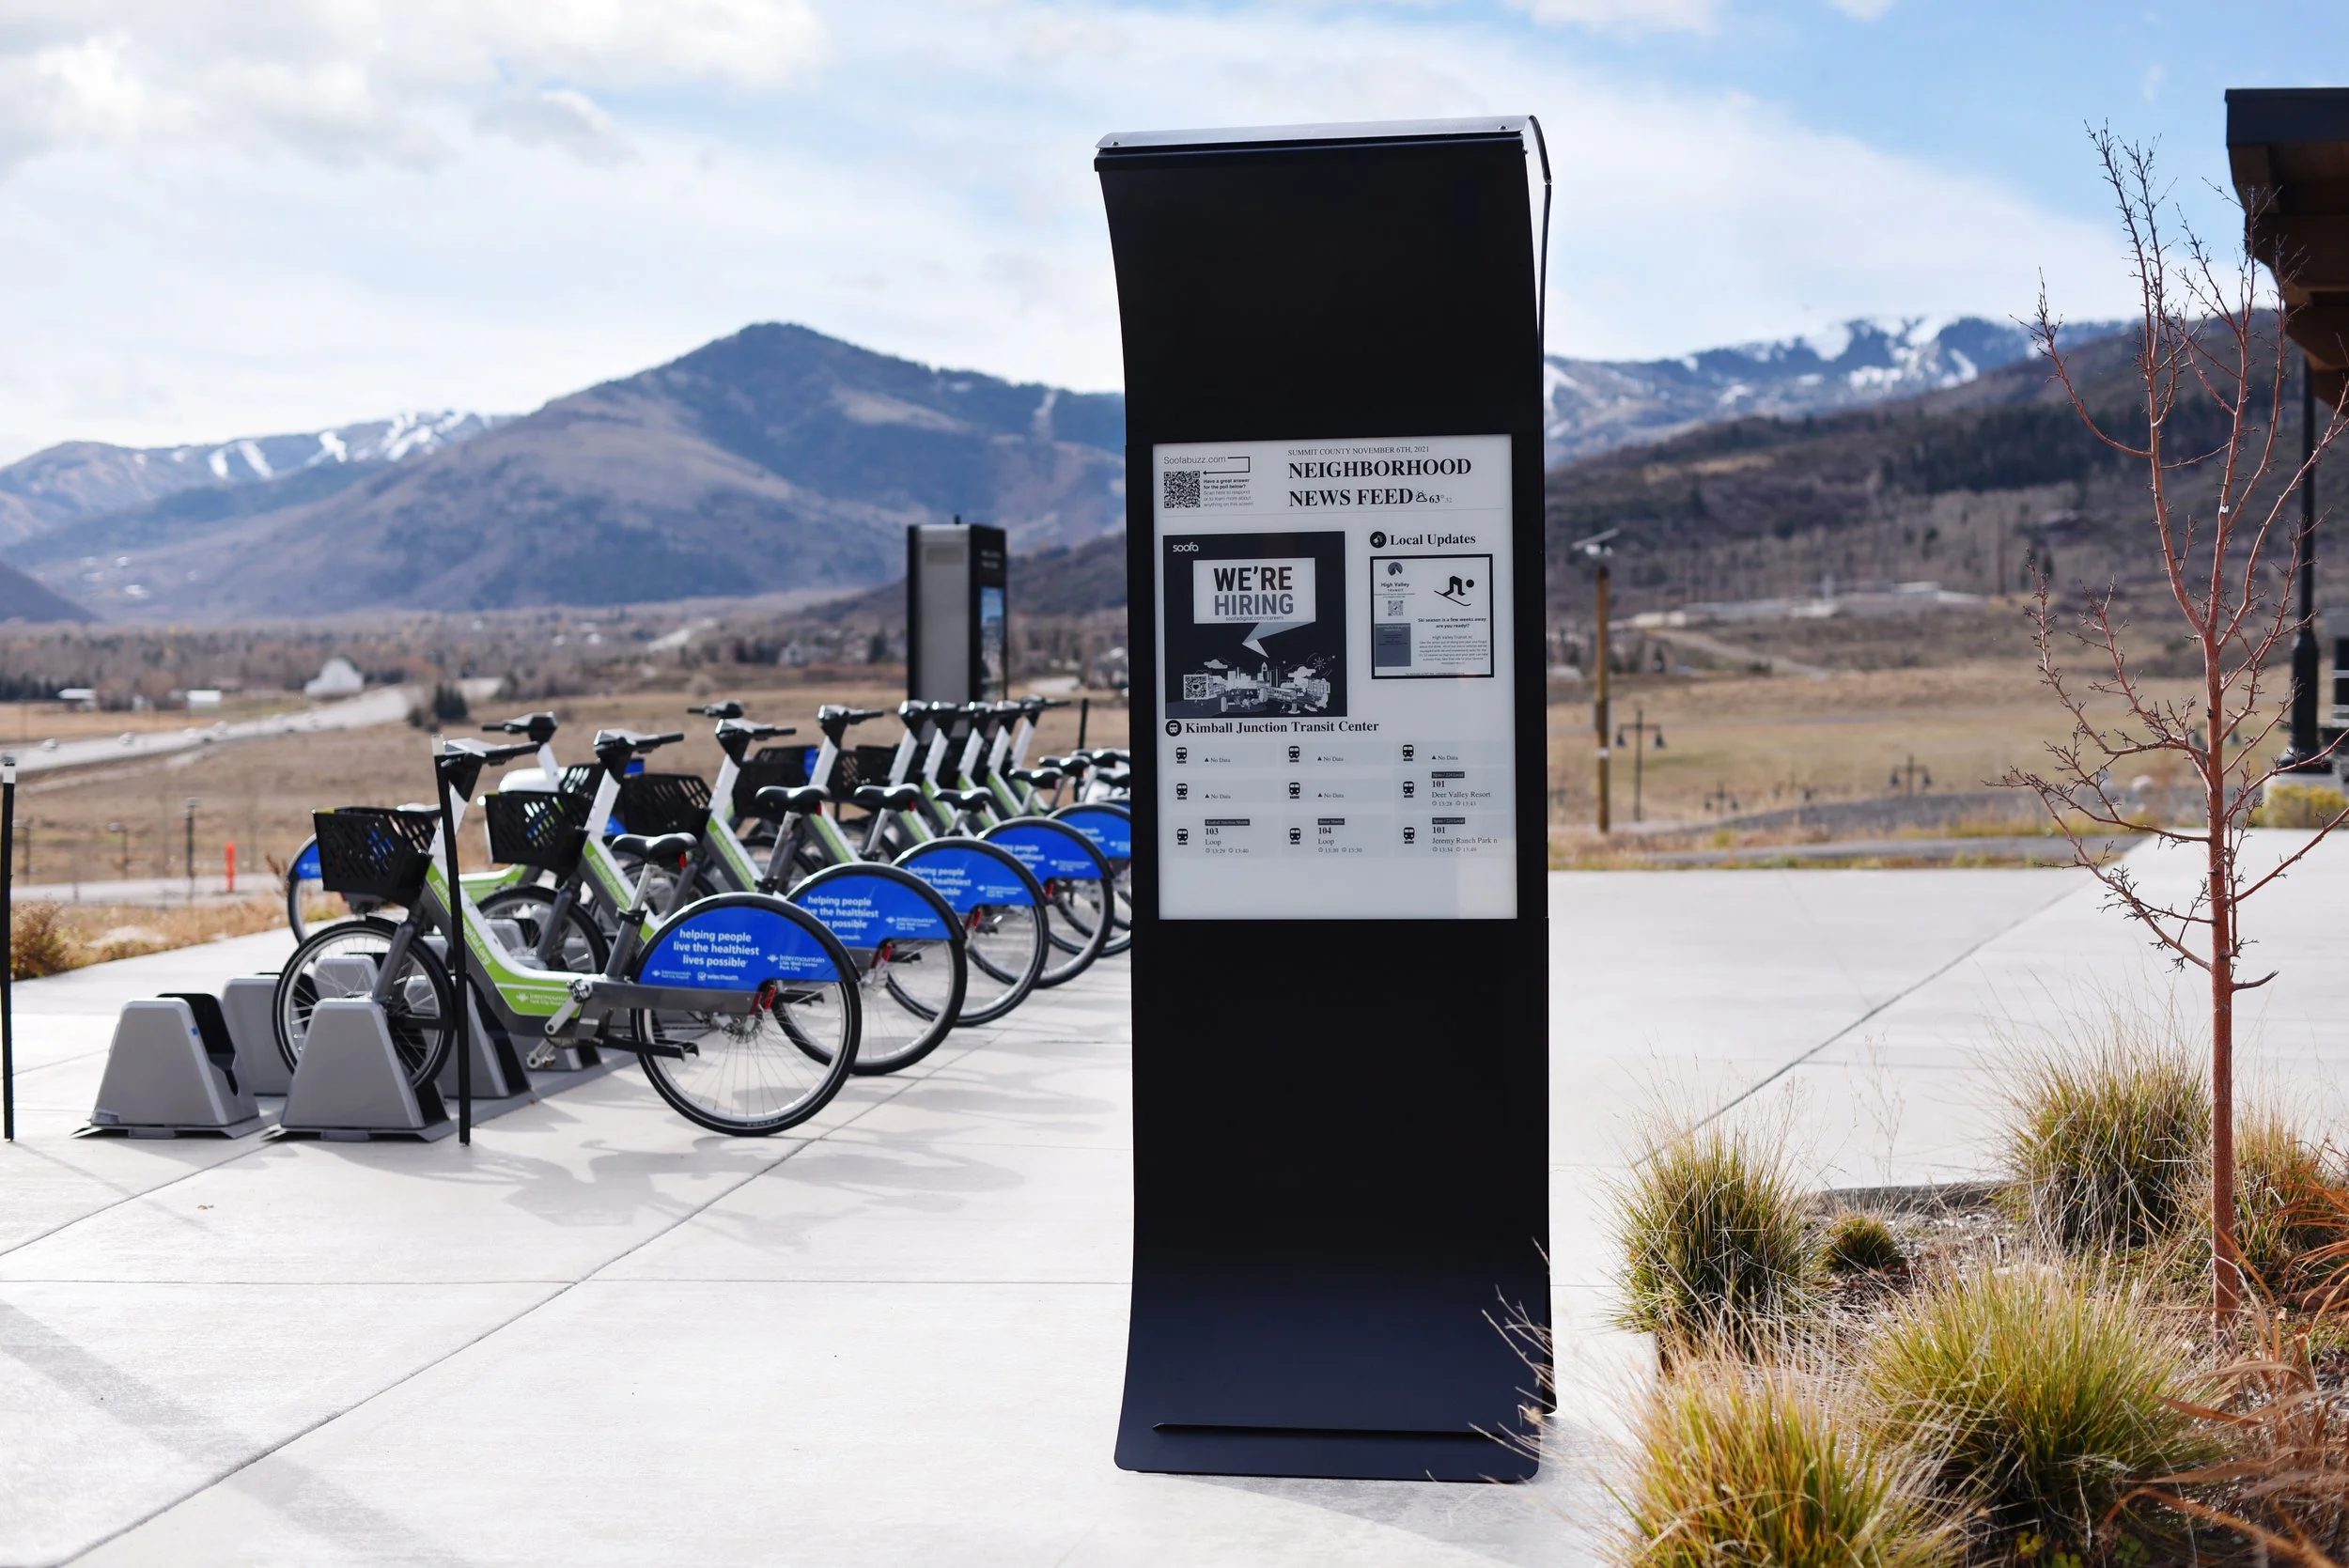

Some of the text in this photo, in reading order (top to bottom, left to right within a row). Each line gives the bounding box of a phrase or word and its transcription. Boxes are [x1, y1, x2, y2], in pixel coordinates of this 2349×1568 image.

[1352, 446, 1395, 455] NOVEMBER
[1163, 456, 1226, 464] Soofabuzz.com
[1288, 458, 1471, 478] NEIGHBORHOOD
[1289, 489, 1351, 506] NEWS
[1357, 488, 1413, 505] FEED
[1173, 542, 1199, 552] soofa
[1390, 534, 1476, 547] Local Updates
[1214, 594, 1294, 615] HIRING
[1186, 721, 1379, 734] Kimball Junction Transit Center
[939, 868, 965, 877] people
[933, 877, 972, 887] healthiest
[807, 895, 872, 908] helping people
[819, 908, 834, 917] the
[835, 908, 879, 918] healthiest
[832, 920, 867, 929] possible
[679, 928, 752, 942] helping people
[673, 942, 760, 955] live the healthiest
[682, 955, 747, 968] lives possible
[779, 955, 825, 963] Intermountain
